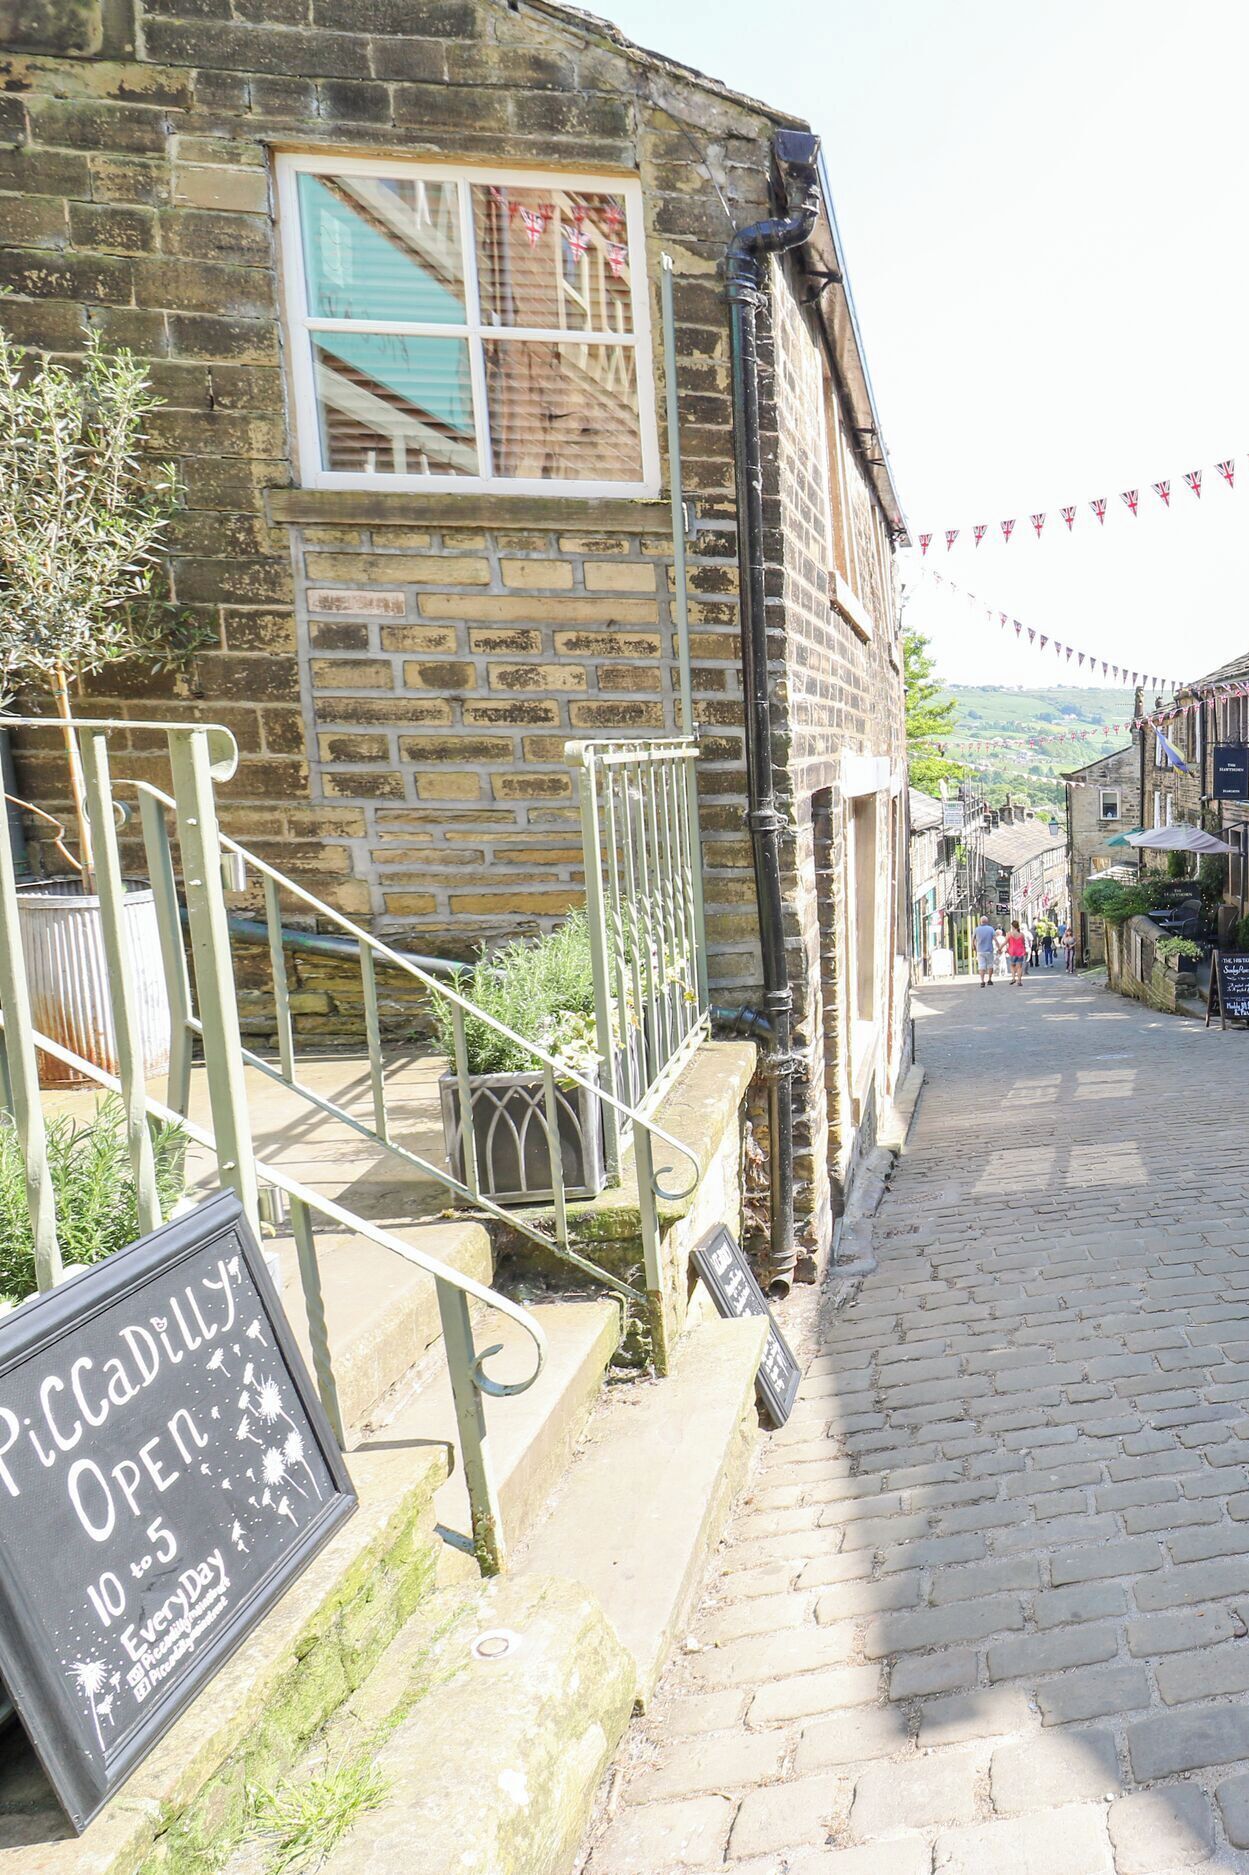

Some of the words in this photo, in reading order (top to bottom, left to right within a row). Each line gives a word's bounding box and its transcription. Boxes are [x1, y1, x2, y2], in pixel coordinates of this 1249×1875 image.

[86, 1571, 126, 1627] 10
[130, 1555, 152, 1578] to
[147, 1516, 177, 1563] 5
